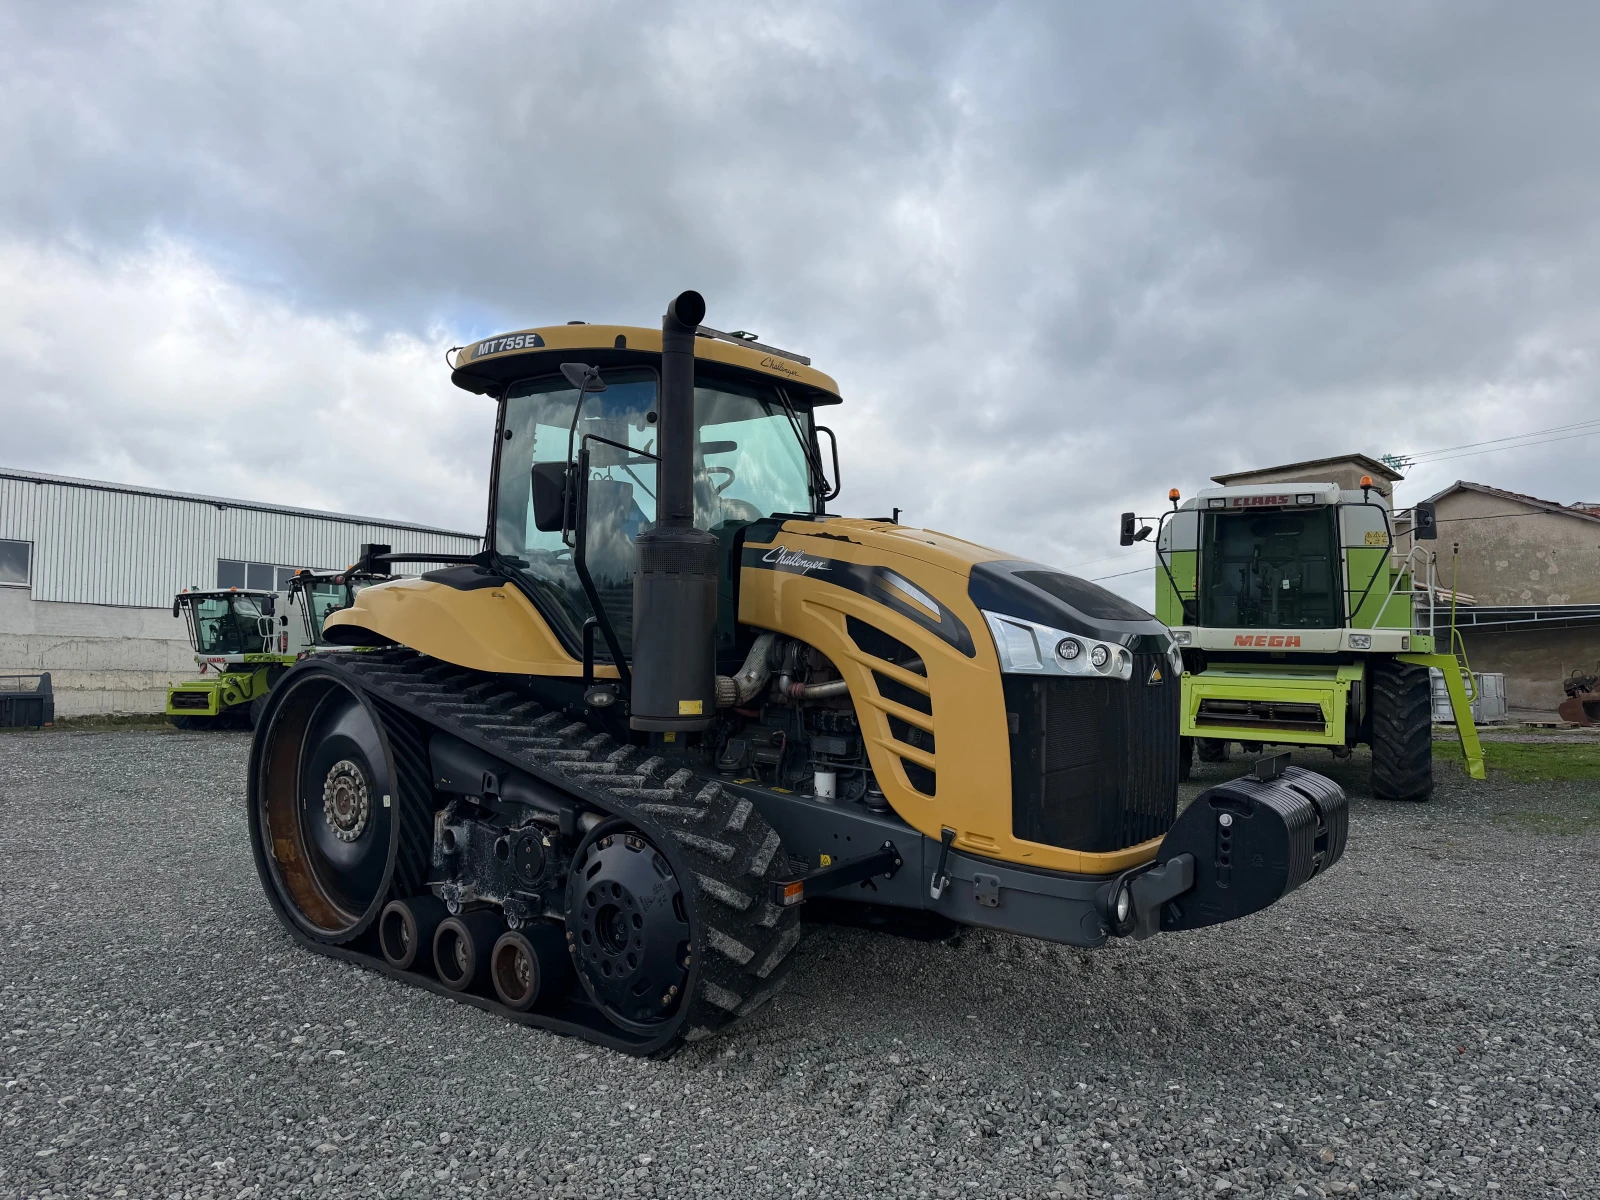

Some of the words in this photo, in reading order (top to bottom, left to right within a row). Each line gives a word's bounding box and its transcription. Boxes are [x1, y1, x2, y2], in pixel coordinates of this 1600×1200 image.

[760, 356, 802, 378] Challenger
[1233, 494, 1290, 507] CLAAS
[762, 545, 833, 575] Challenger
[1233, 634, 1301, 648] MEGA
